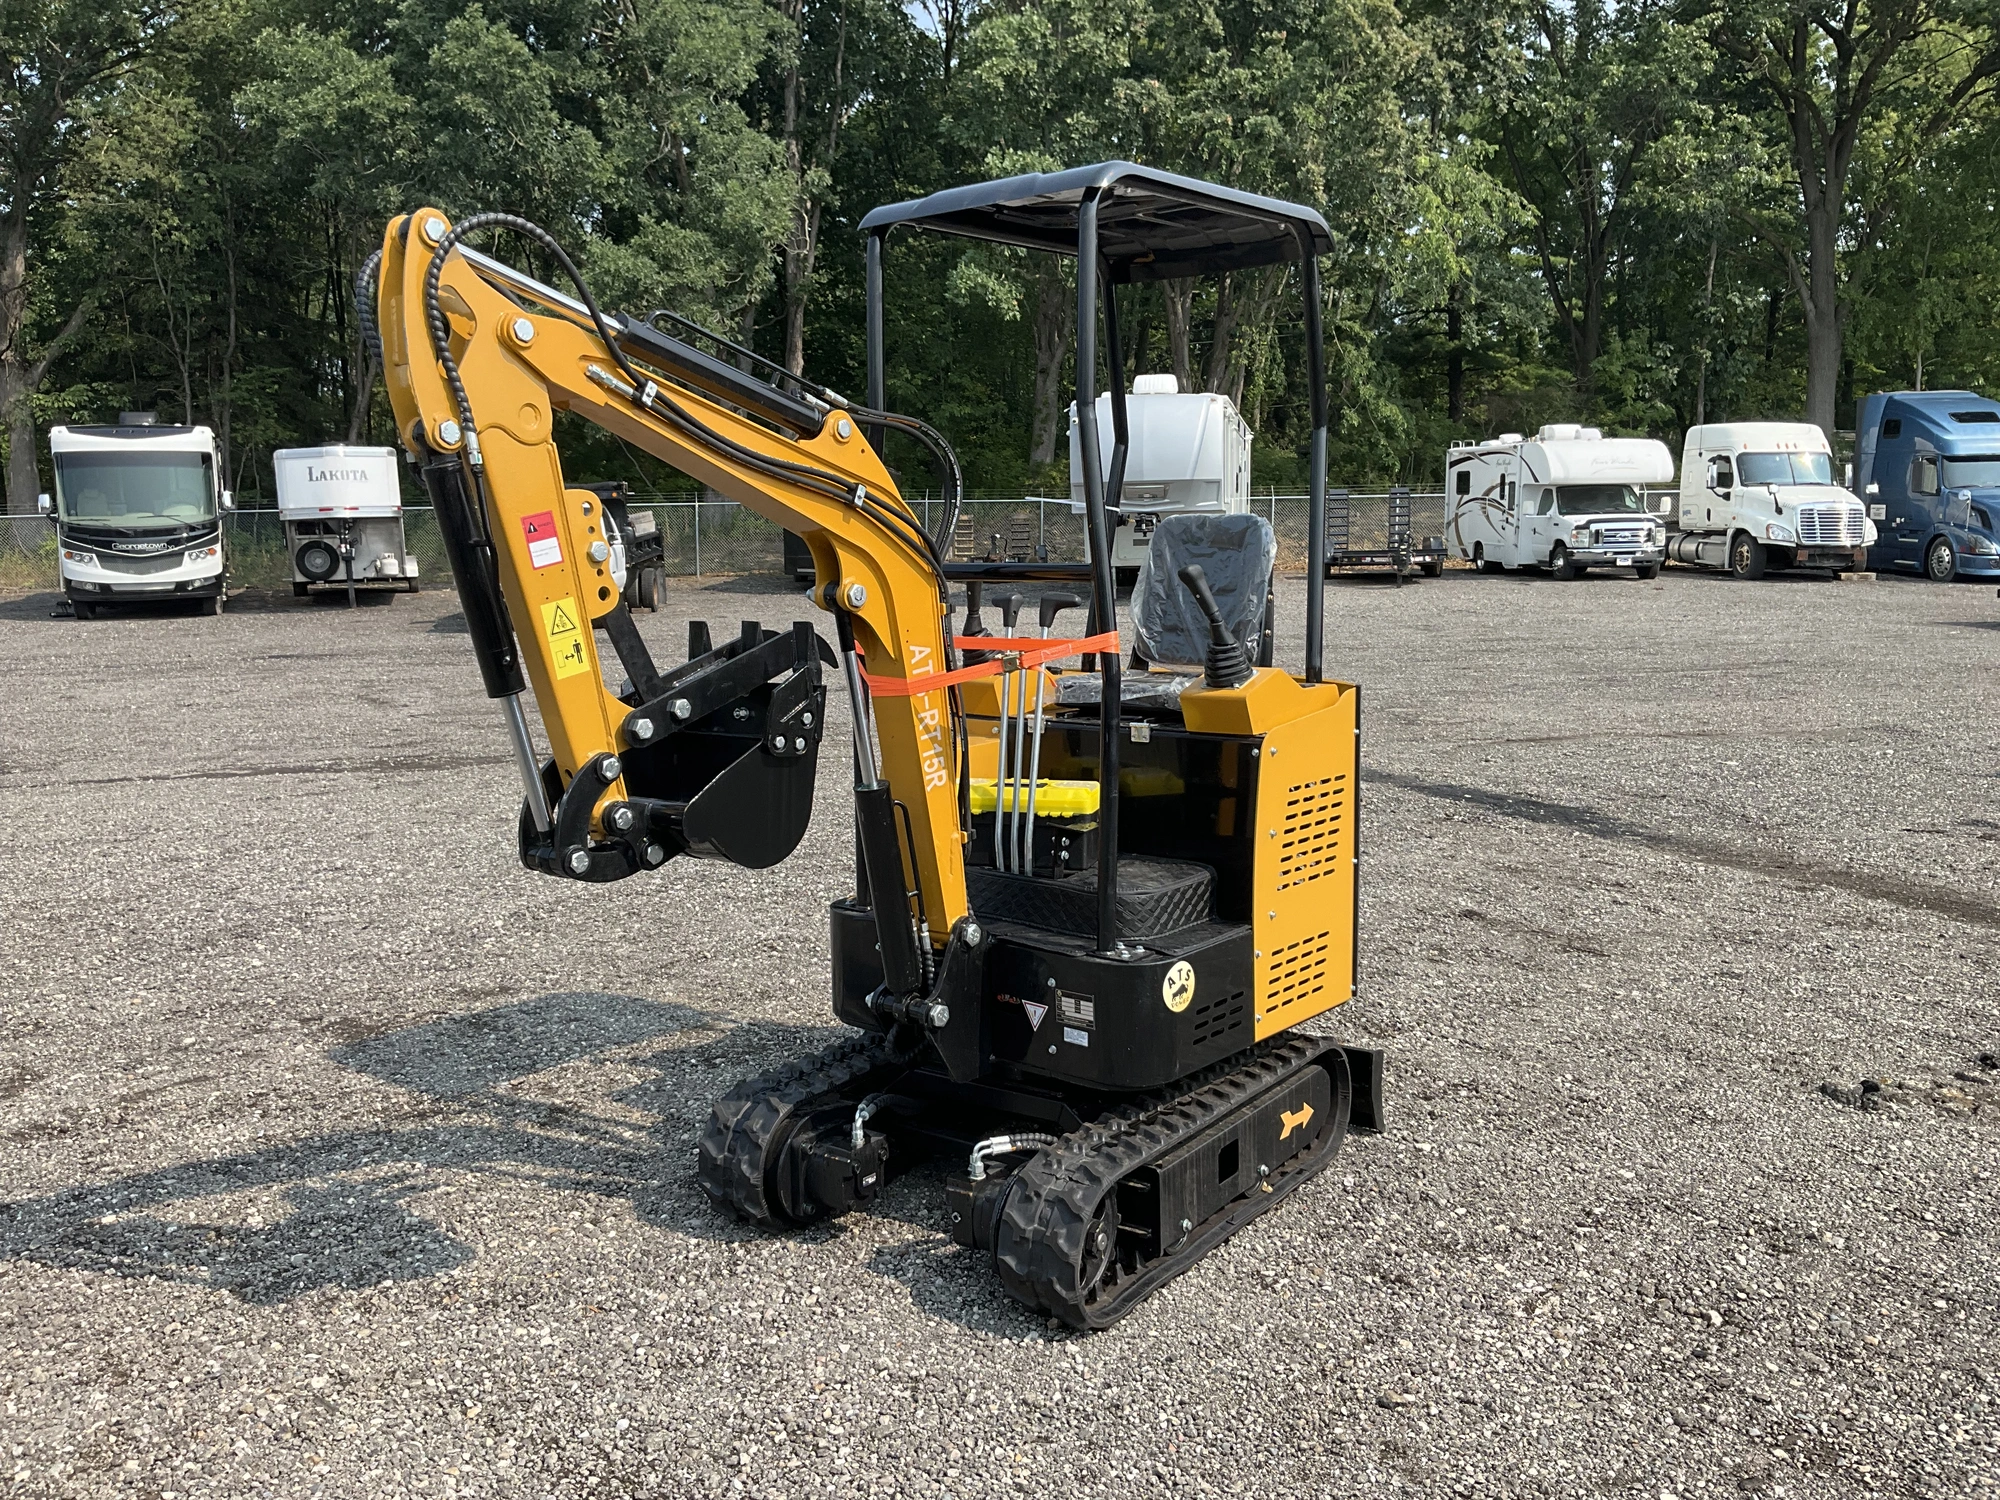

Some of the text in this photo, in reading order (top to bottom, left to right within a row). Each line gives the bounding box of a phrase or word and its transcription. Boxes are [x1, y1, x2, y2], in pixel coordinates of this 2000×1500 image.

[306, 466, 369, 482] LAKOTA
[112, 543, 167, 551] Georgetown
[1167, 968, 1191, 990] ATS
